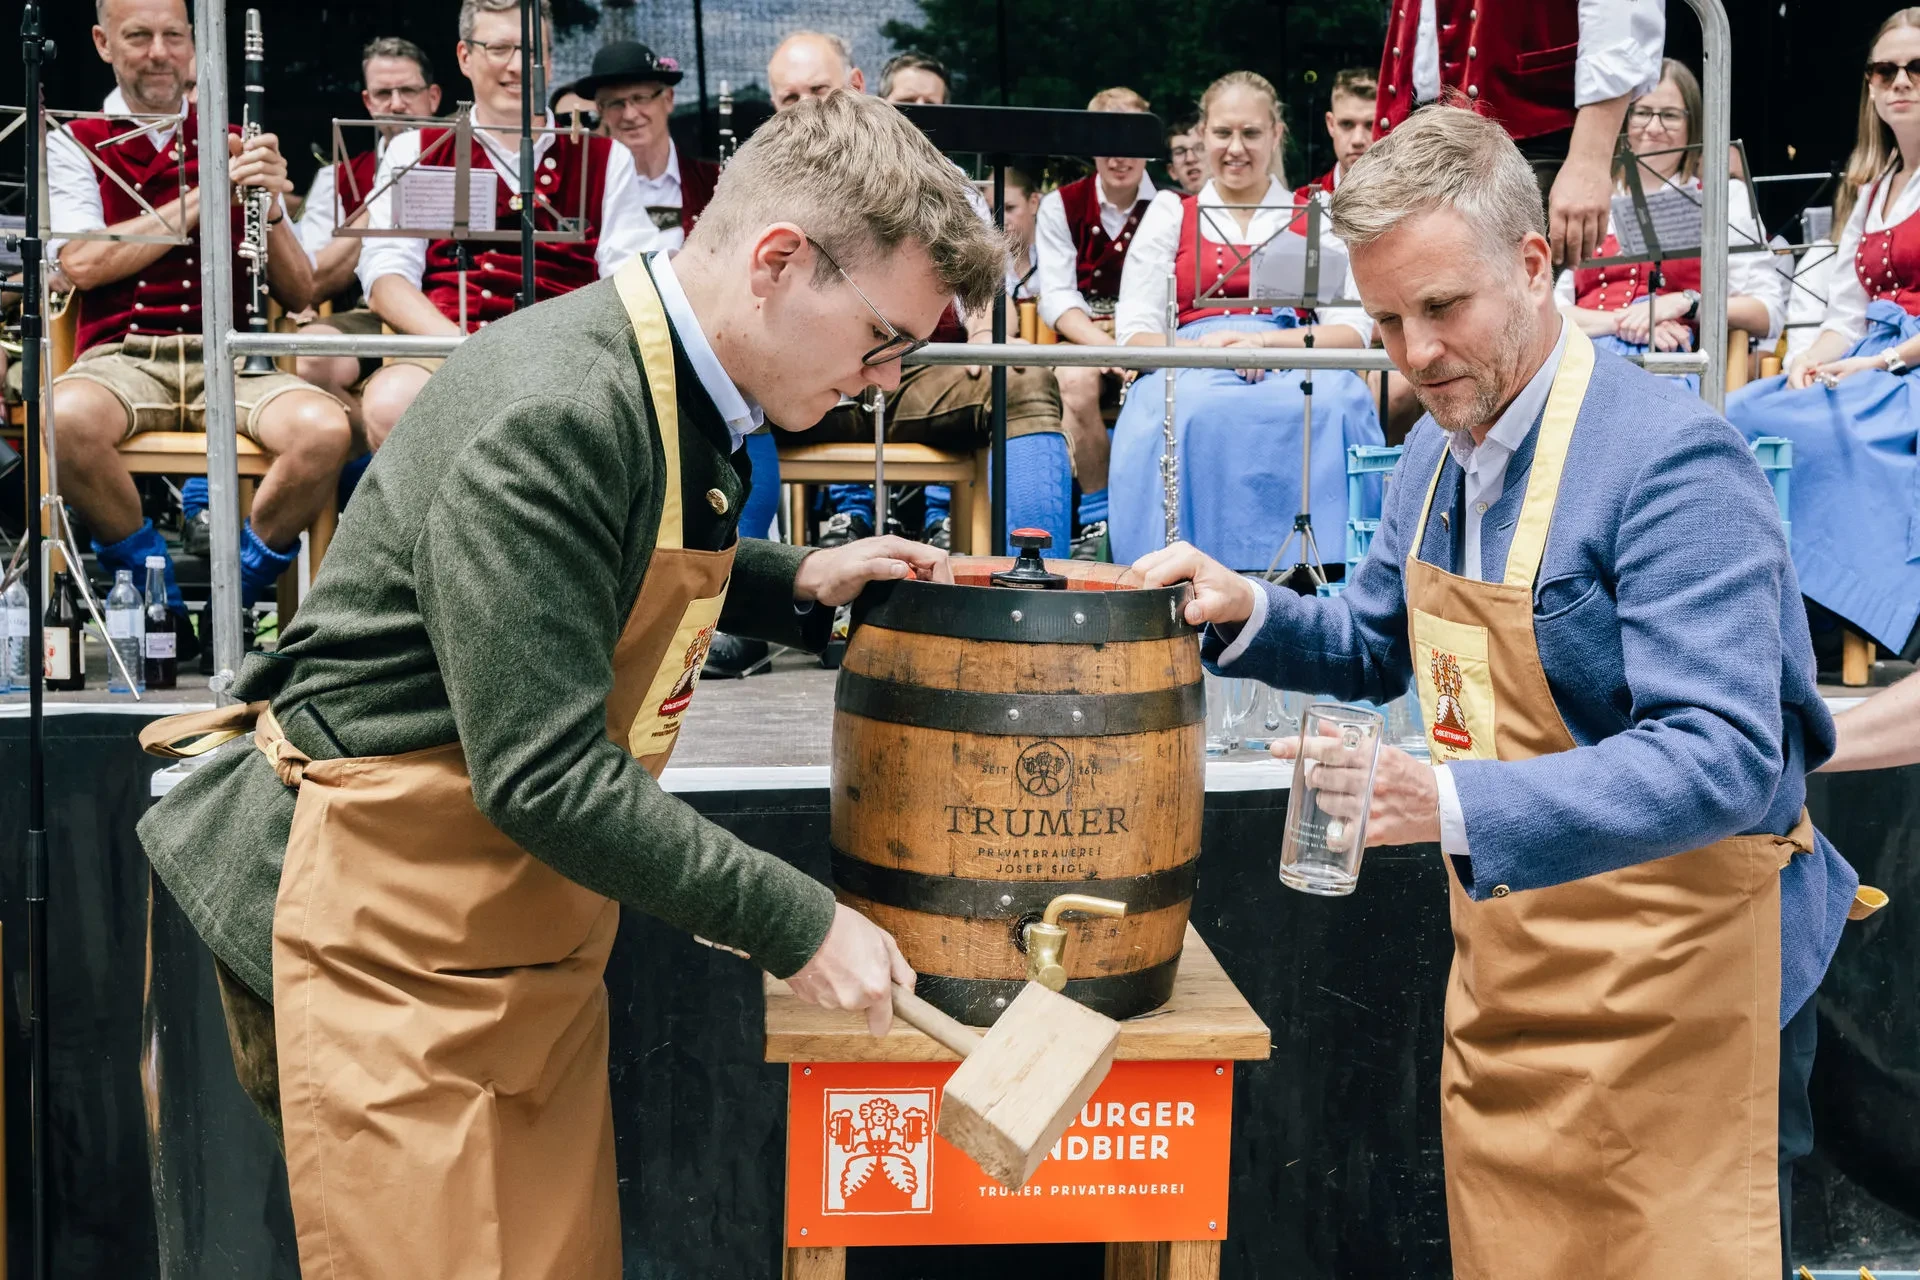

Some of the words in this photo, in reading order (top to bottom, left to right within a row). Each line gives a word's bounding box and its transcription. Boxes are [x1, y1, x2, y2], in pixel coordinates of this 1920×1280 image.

[981, 765, 1009, 775] SEIT
[944, 805, 1129, 837] TRUMER
[978, 847, 1101, 859] PRIVATBRAUEREI
[996, 864, 1044, 875] JOSEF
[1051, 863, 1085, 875] SIGL
[1069, 1101, 1195, 1128] URGER
[1050, 1183, 1185, 1196] PRIVATBRAUEREI
